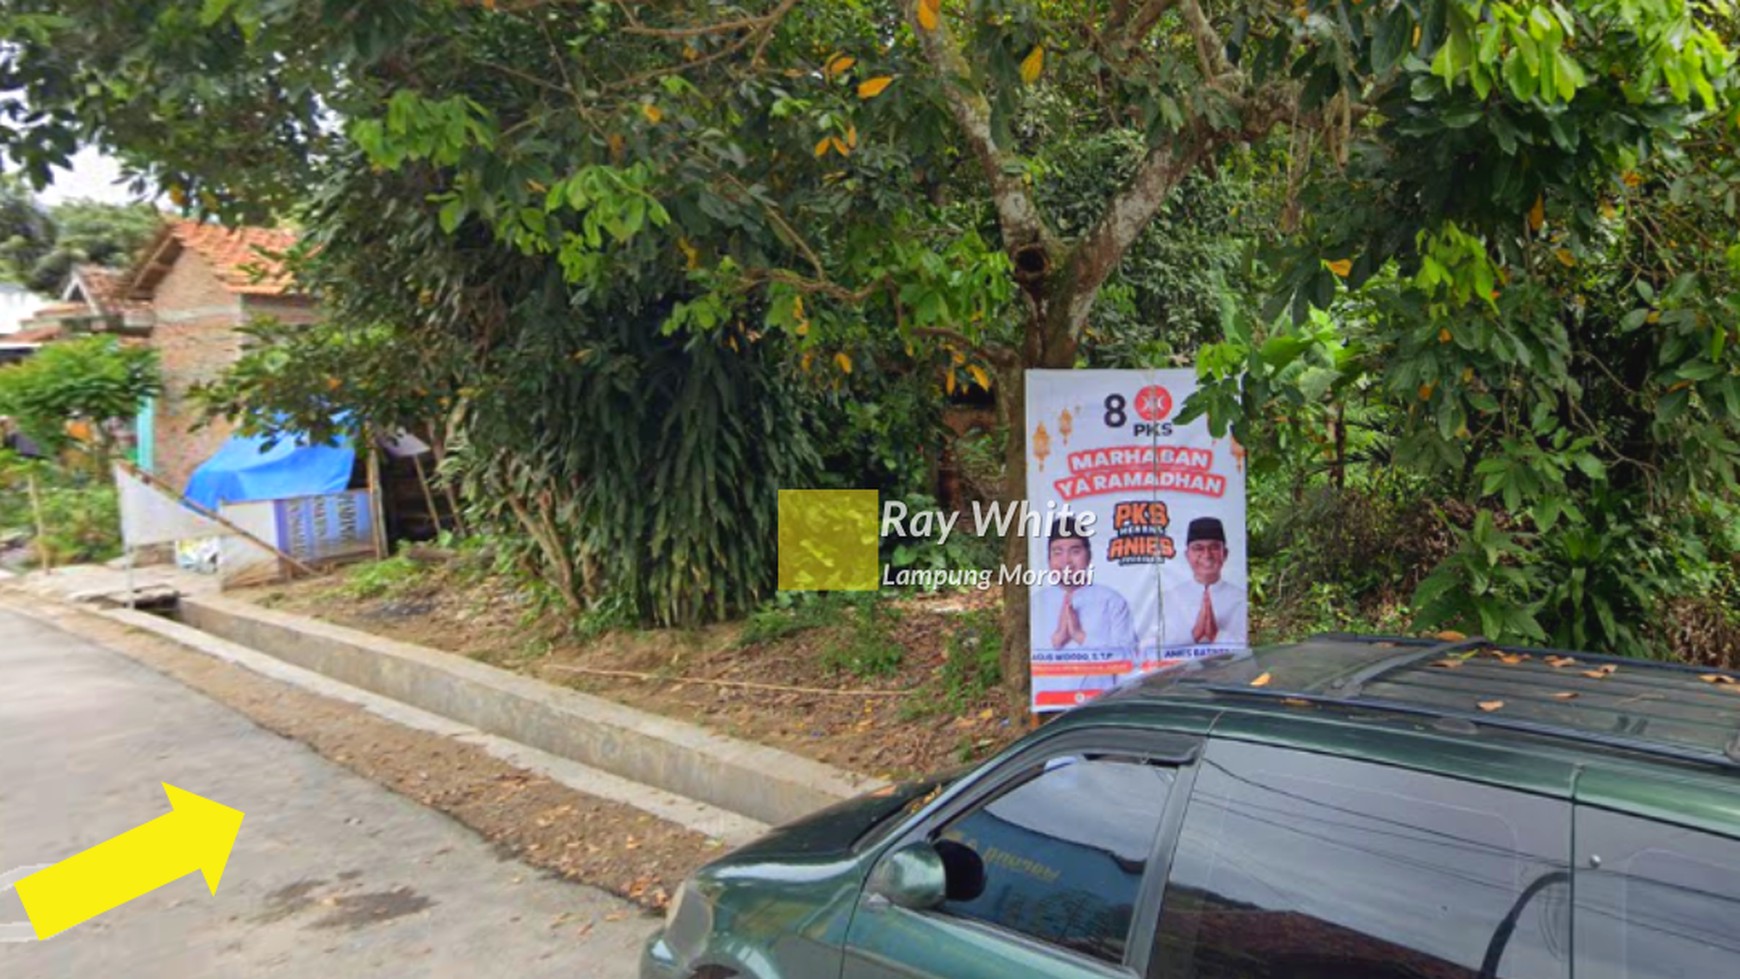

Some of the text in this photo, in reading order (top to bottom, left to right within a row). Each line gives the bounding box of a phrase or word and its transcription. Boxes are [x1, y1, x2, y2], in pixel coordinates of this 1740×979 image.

[1103, 393, 1127, 428] 8
[1133, 422, 1173, 437] PKS
[1071, 450, 1209, 471] MARHABAN
[1057, 471, 1222, 497] YA RAMADHAN
[1109, 537, 1174, 560] ANIES
